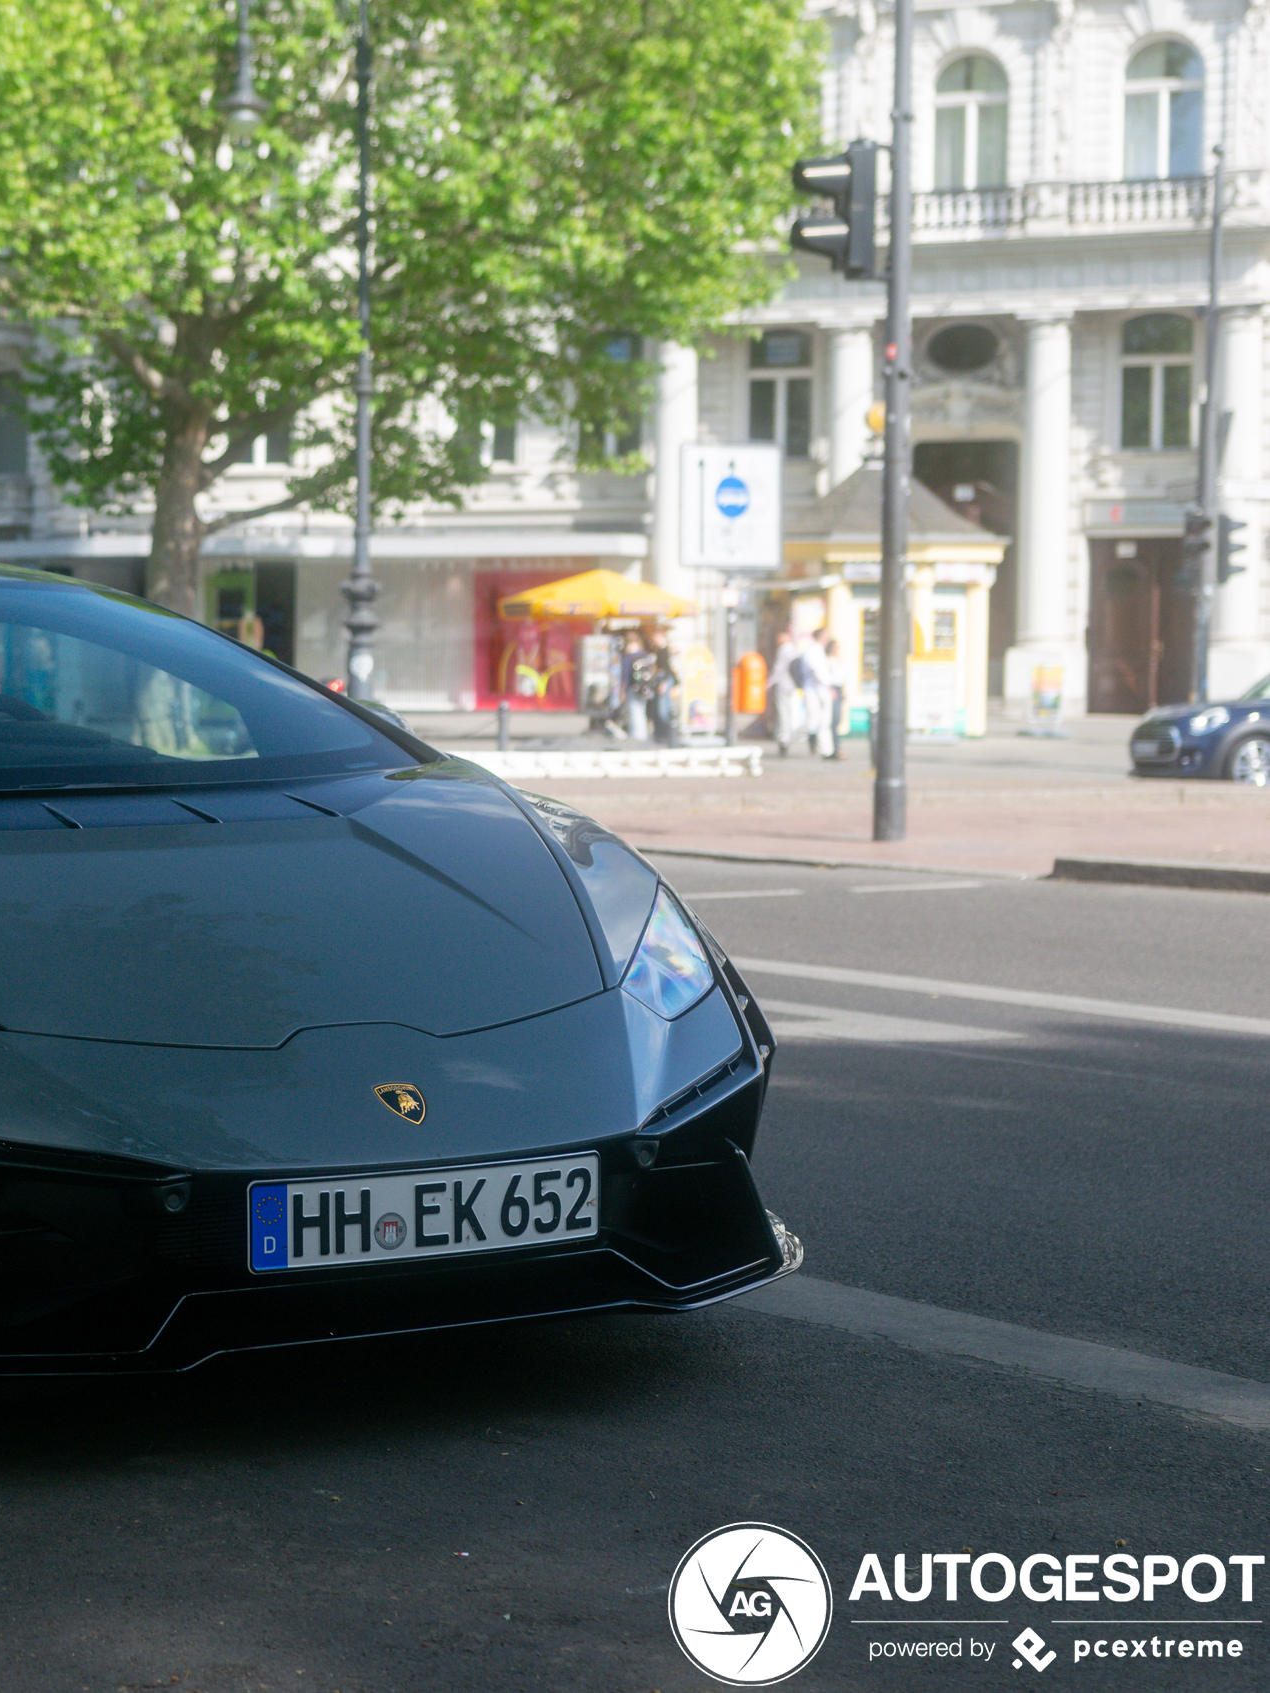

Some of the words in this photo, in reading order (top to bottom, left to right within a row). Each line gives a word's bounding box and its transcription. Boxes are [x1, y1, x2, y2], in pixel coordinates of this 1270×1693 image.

[292, 1189, 371, 1258] HH
[415, 1178, 487, 1247] EK
[501, 1167, 592, 1237] 652
[263, 1236, 277, 1254] D
